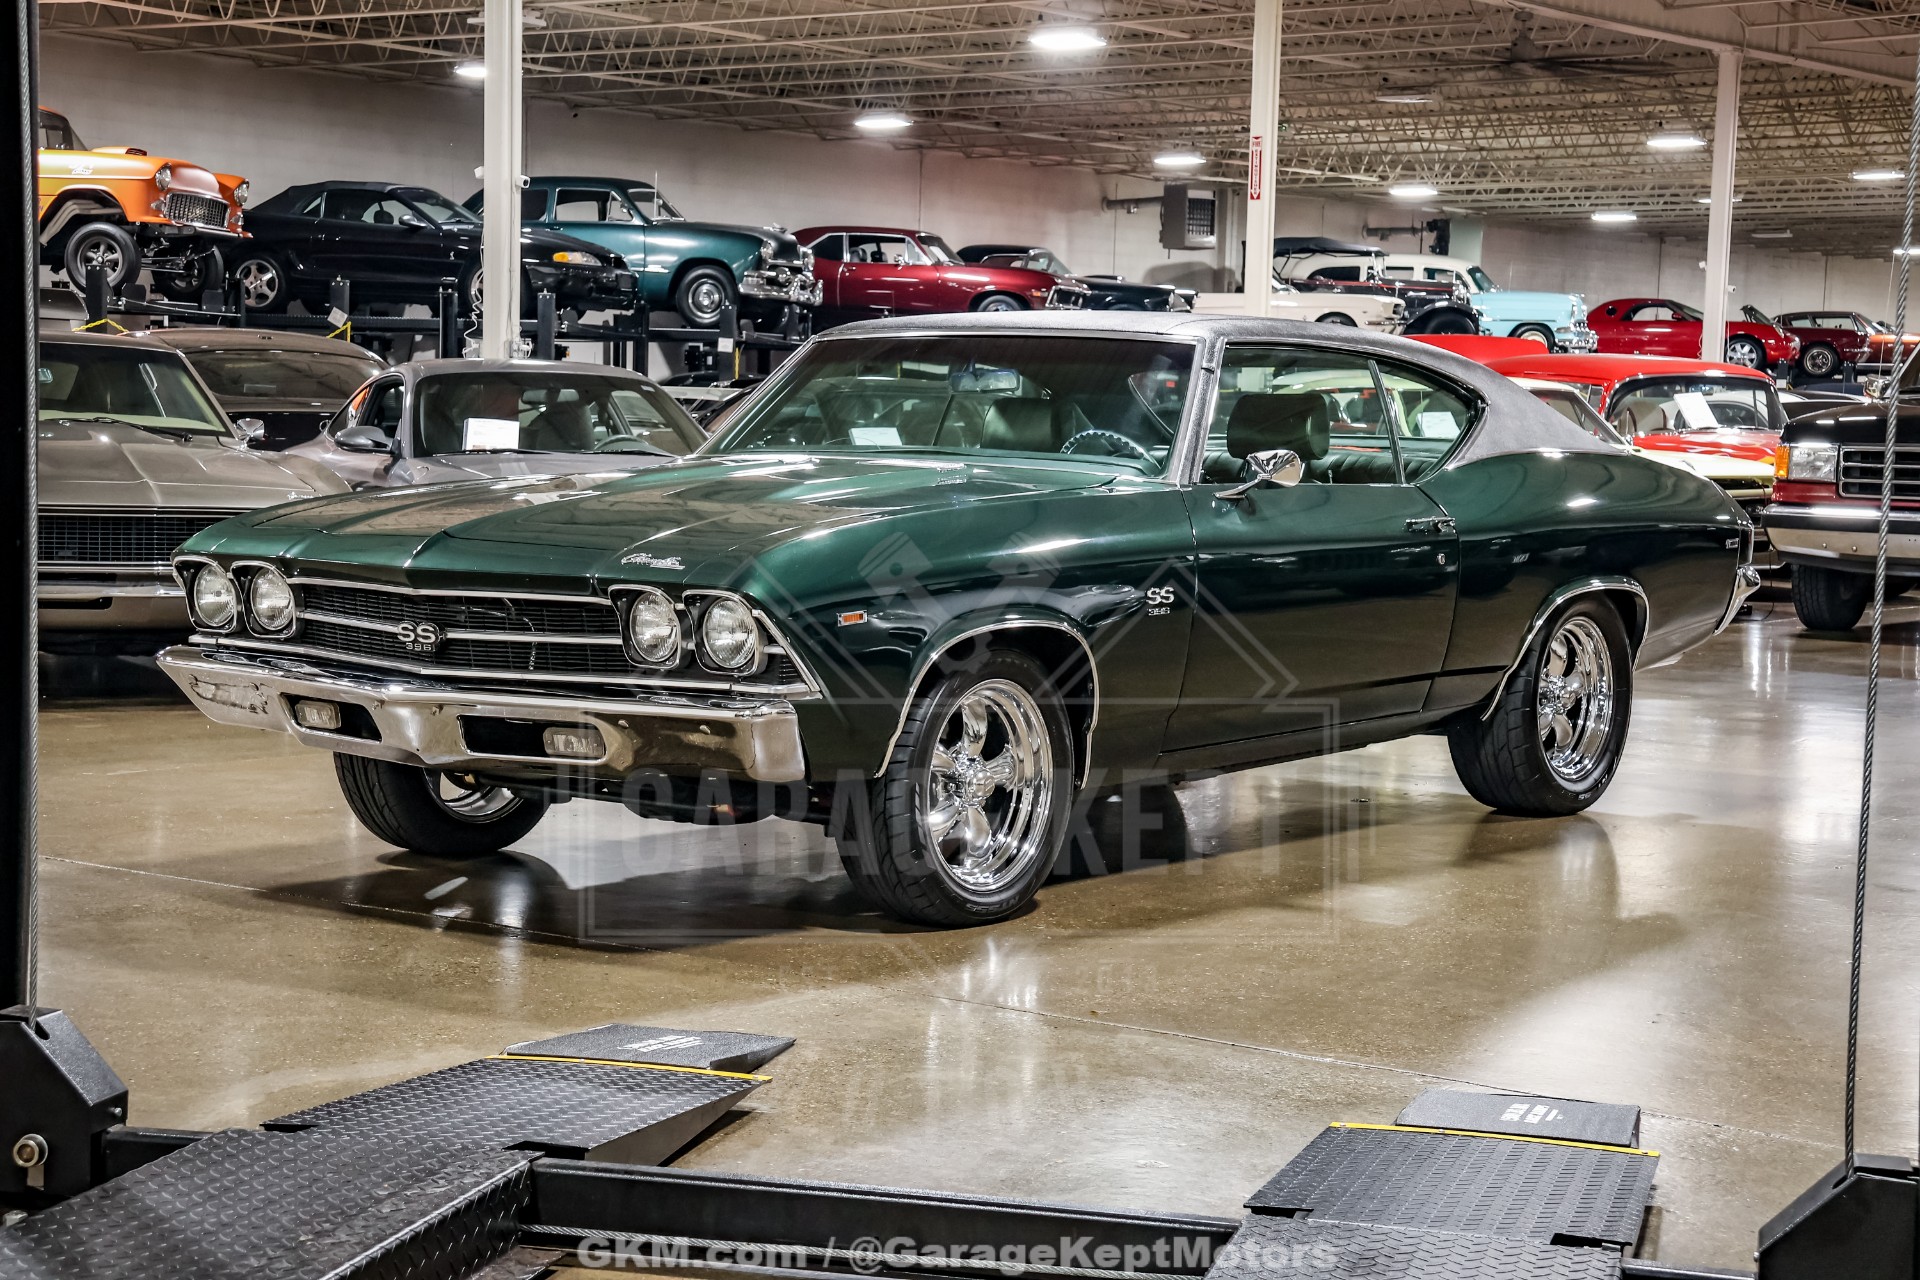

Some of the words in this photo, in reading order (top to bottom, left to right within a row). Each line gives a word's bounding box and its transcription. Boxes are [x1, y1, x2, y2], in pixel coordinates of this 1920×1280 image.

[1146, 586, 1175, 605] SS
[397, 623, 436, 643] SS
[405, 642, 432, 651] 396
